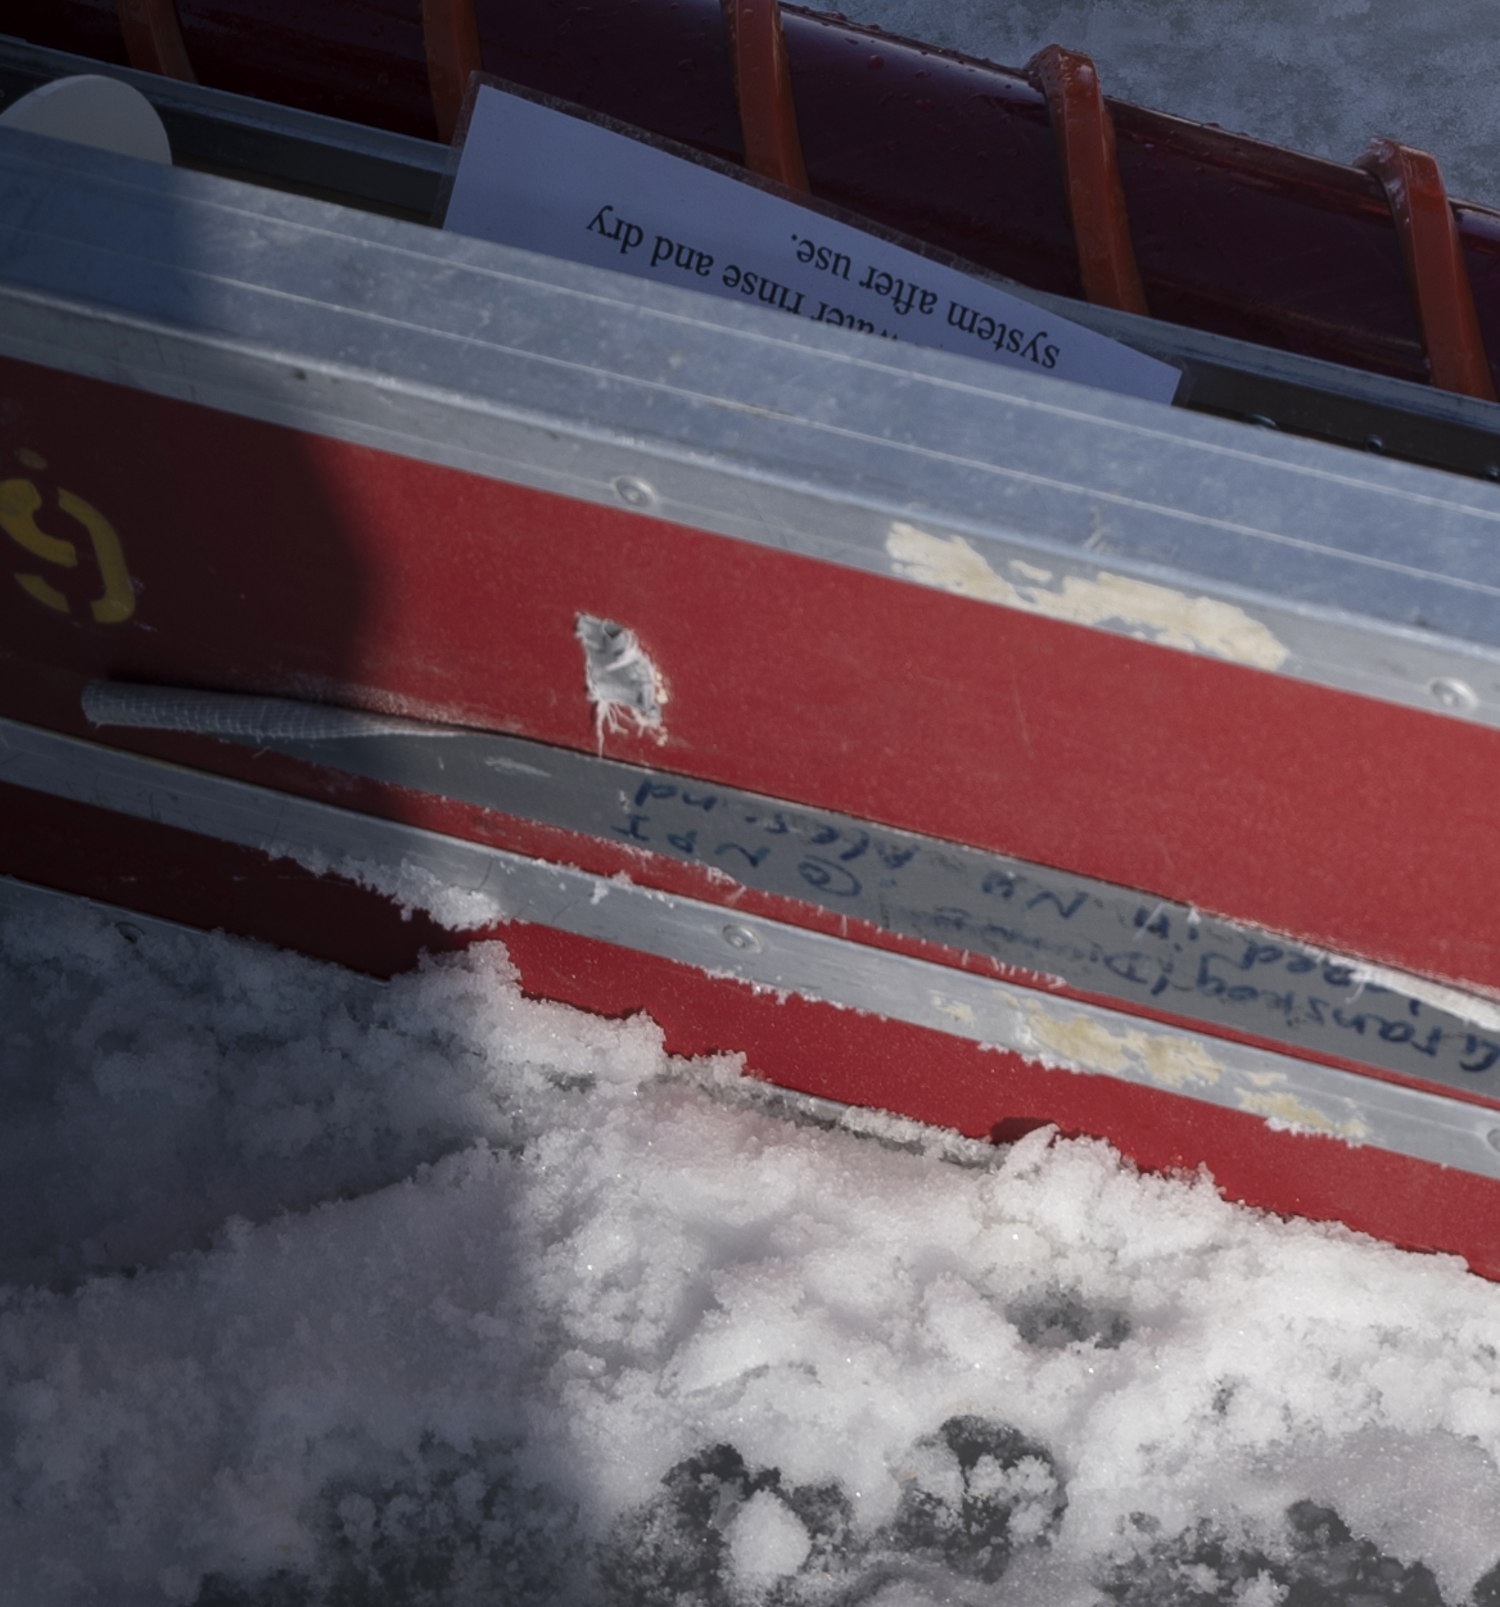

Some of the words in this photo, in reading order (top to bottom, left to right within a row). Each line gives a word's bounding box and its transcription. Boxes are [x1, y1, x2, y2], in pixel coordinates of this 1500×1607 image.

[586, 205, 643, 255] dry
[650, 236, 714, 278] and
[790, 233, 851, 281] use.
[722, 264, 806, 316] rinse
[859, 266, 938, 315] after
[947, 301, 1060, 369] system
[611, 815, 771, 868] NPI
